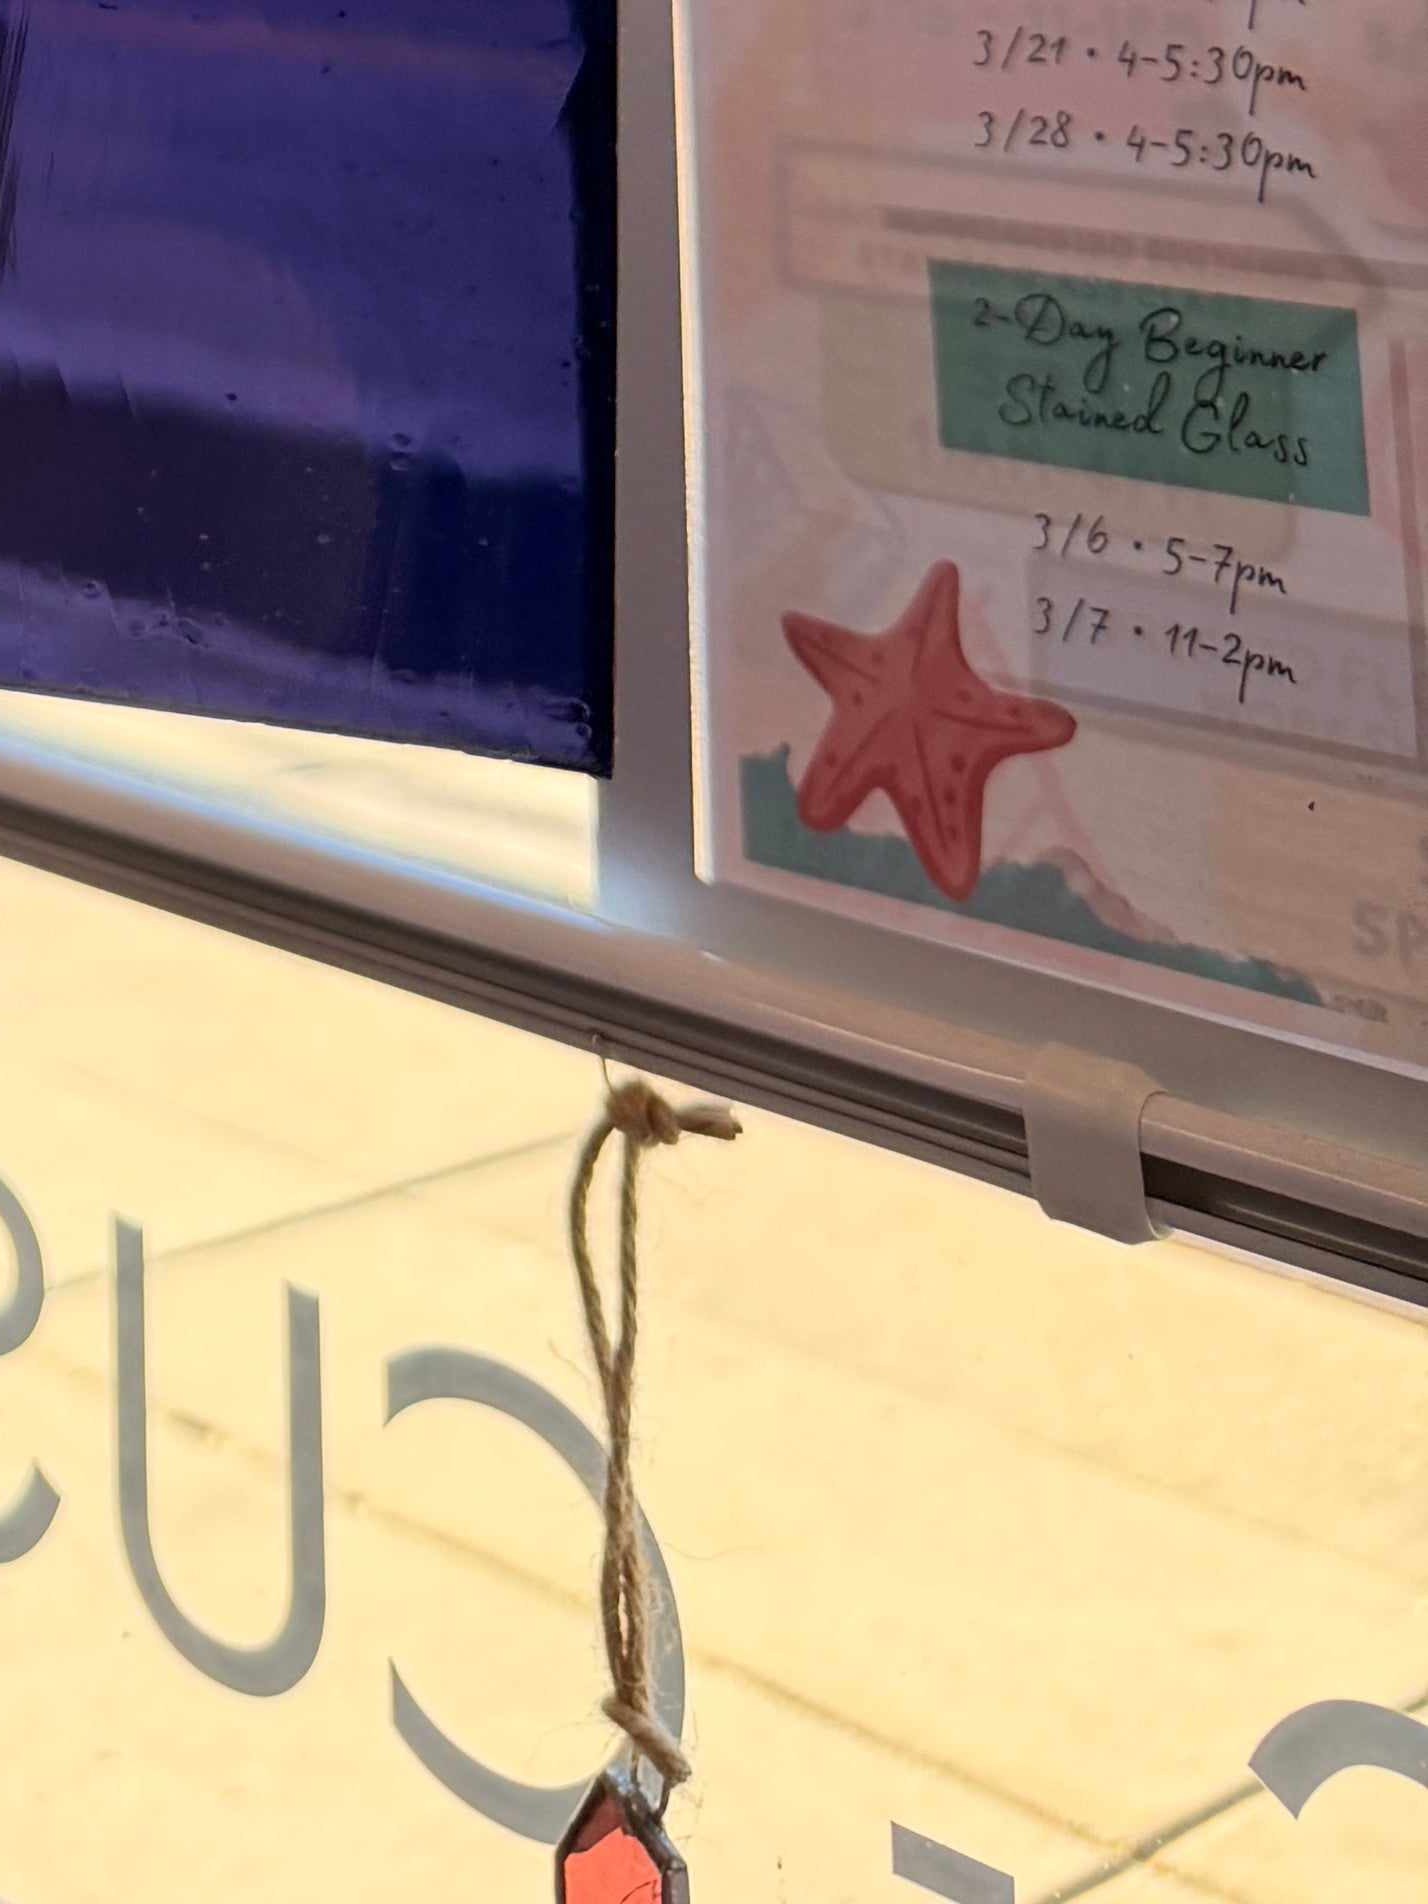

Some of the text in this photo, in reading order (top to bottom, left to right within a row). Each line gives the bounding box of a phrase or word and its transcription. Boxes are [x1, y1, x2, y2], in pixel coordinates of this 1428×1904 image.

[973, 26, 1307, 115] 3/21 4-5:30pm
[973, 110, 1317, 204] 3/28 4-5:30pm
[973, 294, 1328, 407] 2-Day Beginner
[998, 371, 1310, 466] Stained Glass
[1032, 512, 1289, 615] 3/6 5-7pm
[1032, 596, 1298, 703] 3/7 11-2pm
